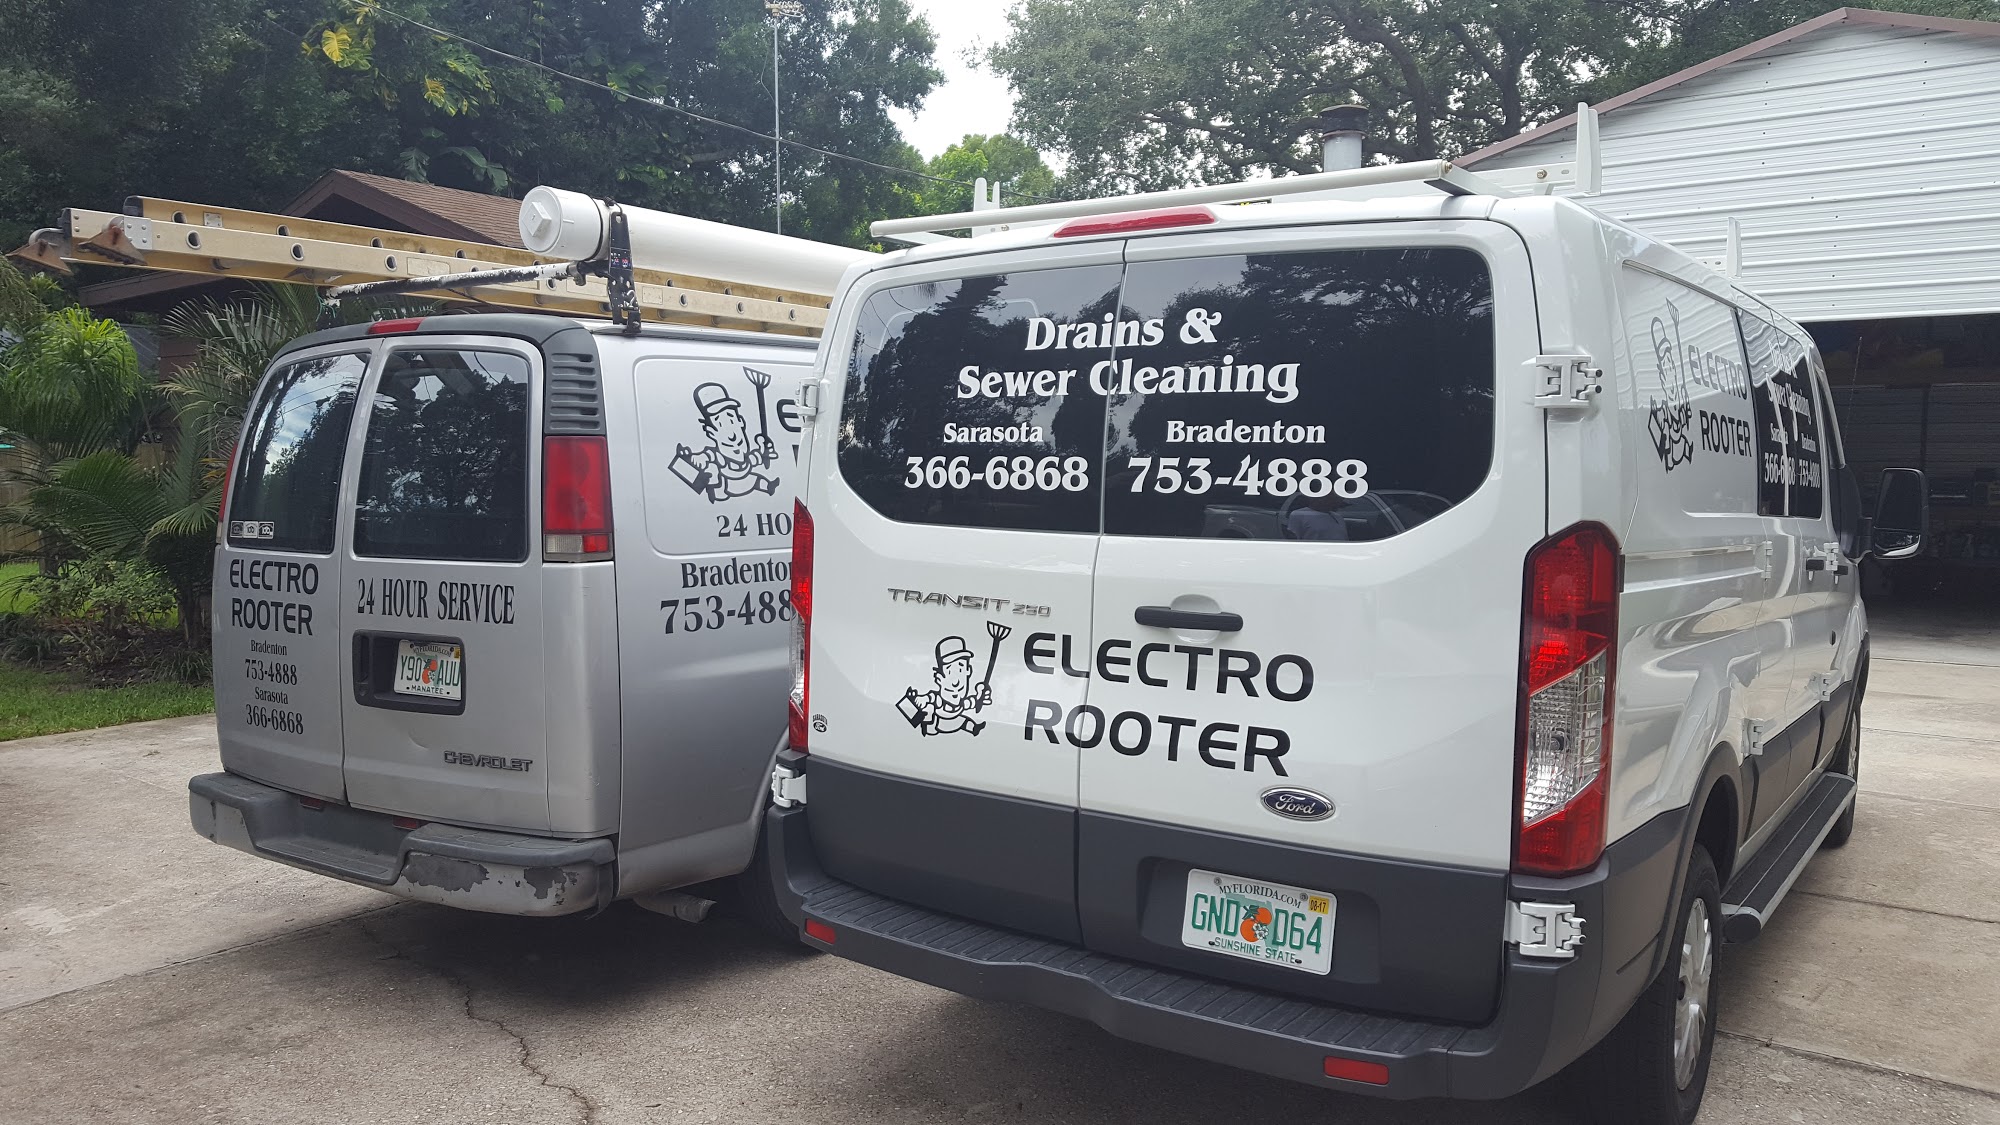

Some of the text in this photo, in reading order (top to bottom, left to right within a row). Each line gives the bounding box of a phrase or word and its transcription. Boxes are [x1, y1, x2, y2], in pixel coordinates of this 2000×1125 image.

[1024, 308, 1222, 351] Drains &
[958, 354, 1301, 404] Sewer Cleaning
[1688, 345, 1747, 400] ELECTRO
[943, 422, 1043, 444] Sarasota
[1166, 419, 1326, 444] Bradenton
[1699, 410, 1752, 457] ROOTER
[1770, 423, 1788, 444] Sarata
[904, 455, 1089, 492] 366-6868
[1127, 454, 1369, 499] 753-4888
[1764, 452, 1796, 485] 366-668
[717, 512, 793, 537] 24 HO
[229, 559, 319, 595] ELECTRO
[232, 597, 313, 636] ROOTER
[357, 577, 516, 625] 24 HOUR SERVICE
[660, 589, 797, 634] 753-488
[887, 587, 1051, 617] TRANSIT 250
[250, 639, 288, 656] Bradenton
[245, 659, 298, 686] 753-4888
[1023, 632, 1314, 702] ELECTRO
[254, 686, 289, 705] Sarasota
[411, 684, 444, 695] MANATEE
[246, 704, 304, 735] 366-6868
[1024, 699, 1291, 777] ROOTER
[444, 750, 533, 772] CHEVROLET
[1275, 794, 1316, 814] Ford
[1218, 883, 1303, 909] MYFLORIDA.COM
[1191, 892, 1323, 954] GND D64
[1214, 936, 1296, 964] SUNSHINE STATE
